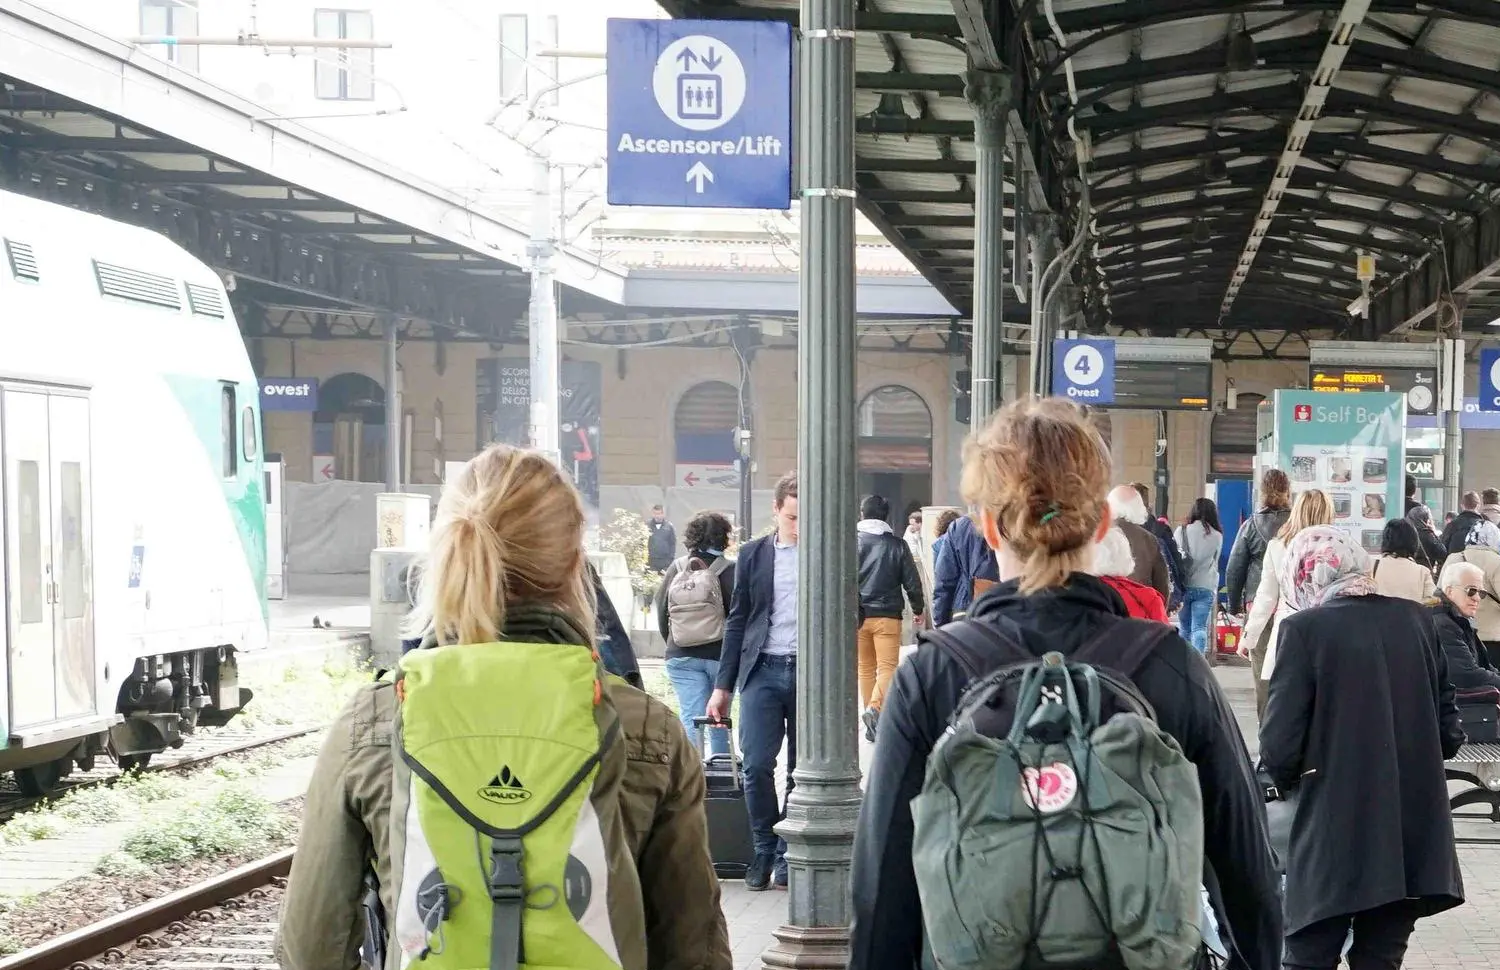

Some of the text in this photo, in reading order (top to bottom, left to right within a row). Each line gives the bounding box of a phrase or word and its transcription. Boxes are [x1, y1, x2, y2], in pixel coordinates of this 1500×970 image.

[616, 133, 783, 157] Ascensore/Lift
[502, 367, 529, 377] SCOPR
[1074, 355, 1091, 375] 4
[263, 383, 310, 396] ovest
[1066, 386, 1100, 398] Ovest
[1316, 406, 1351, 423] Self
